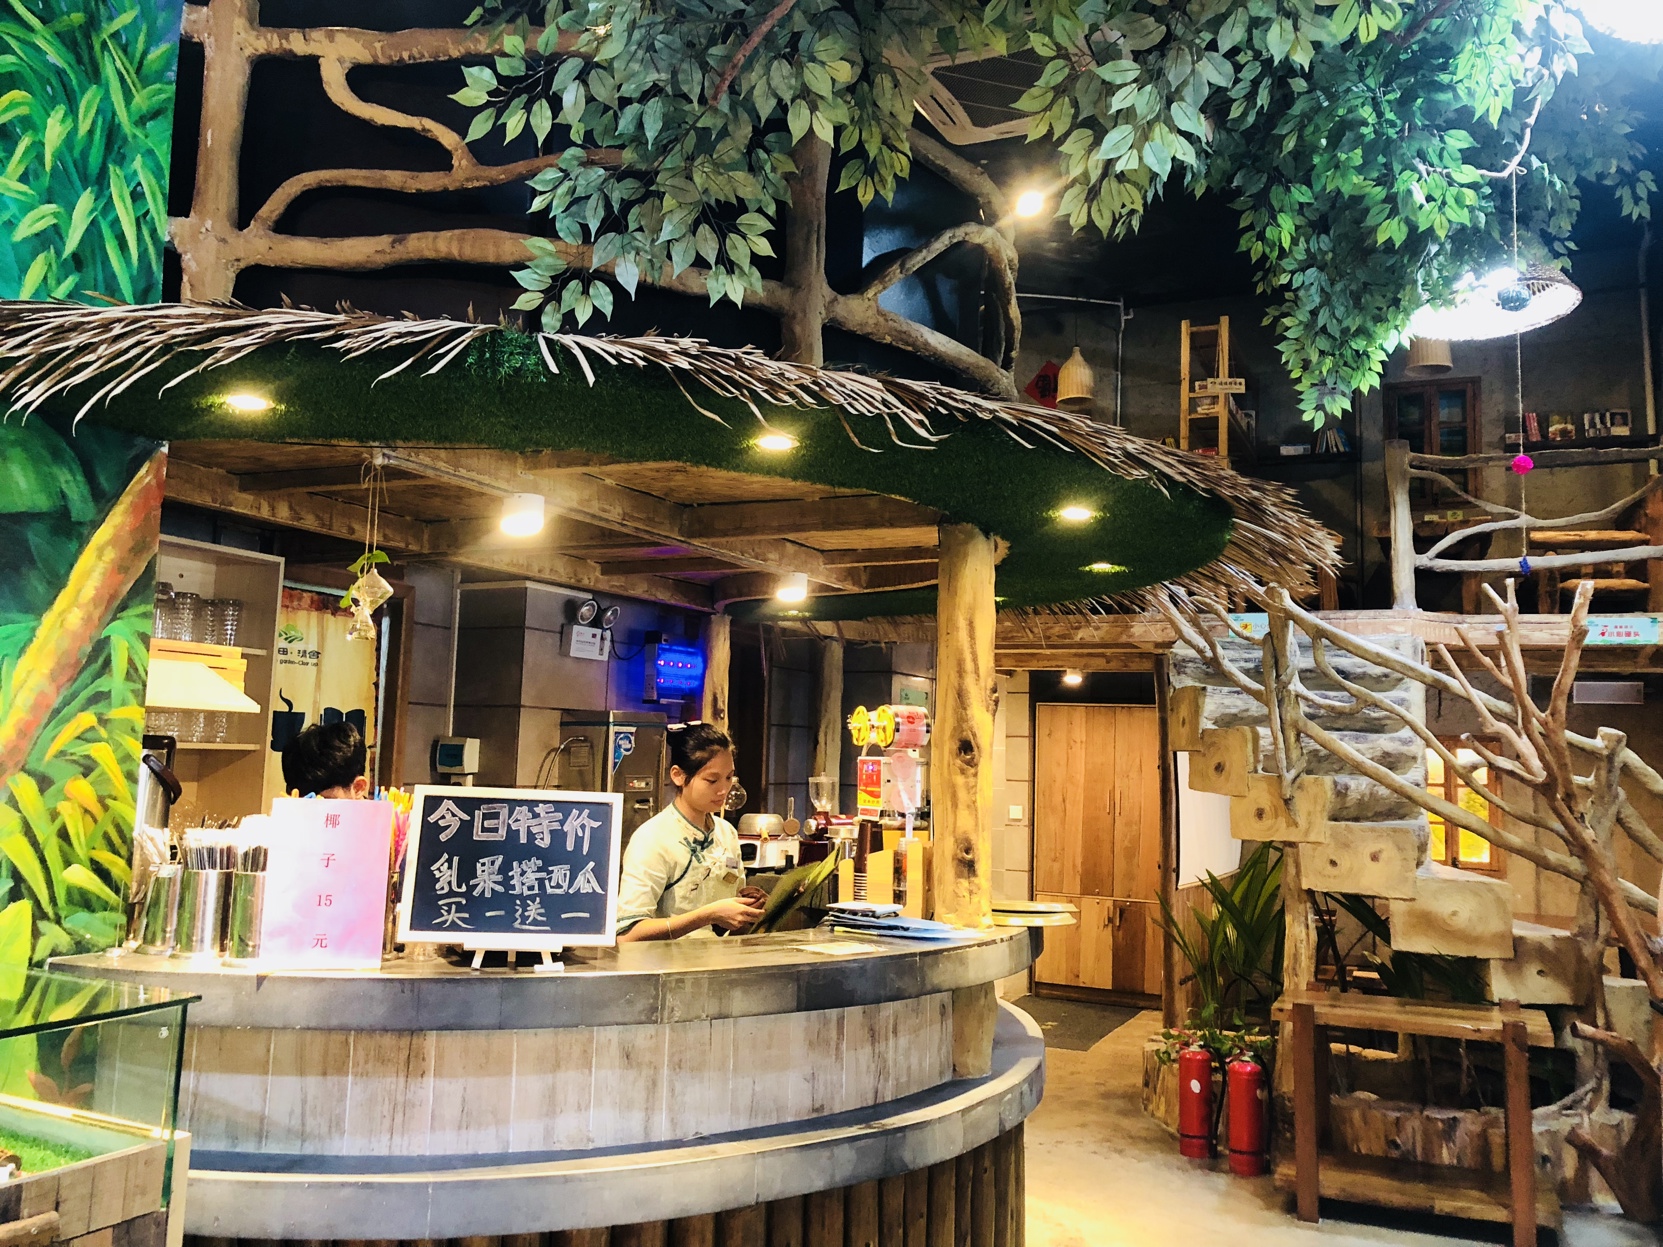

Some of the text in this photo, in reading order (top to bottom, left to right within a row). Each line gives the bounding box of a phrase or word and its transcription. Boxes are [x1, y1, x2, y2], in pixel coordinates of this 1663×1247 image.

[427, 798, 602, 856] 今日特价
[430, 852, 605, 898] 乳果搭西瓜
[431, 897, 591, 931] 买一送一
